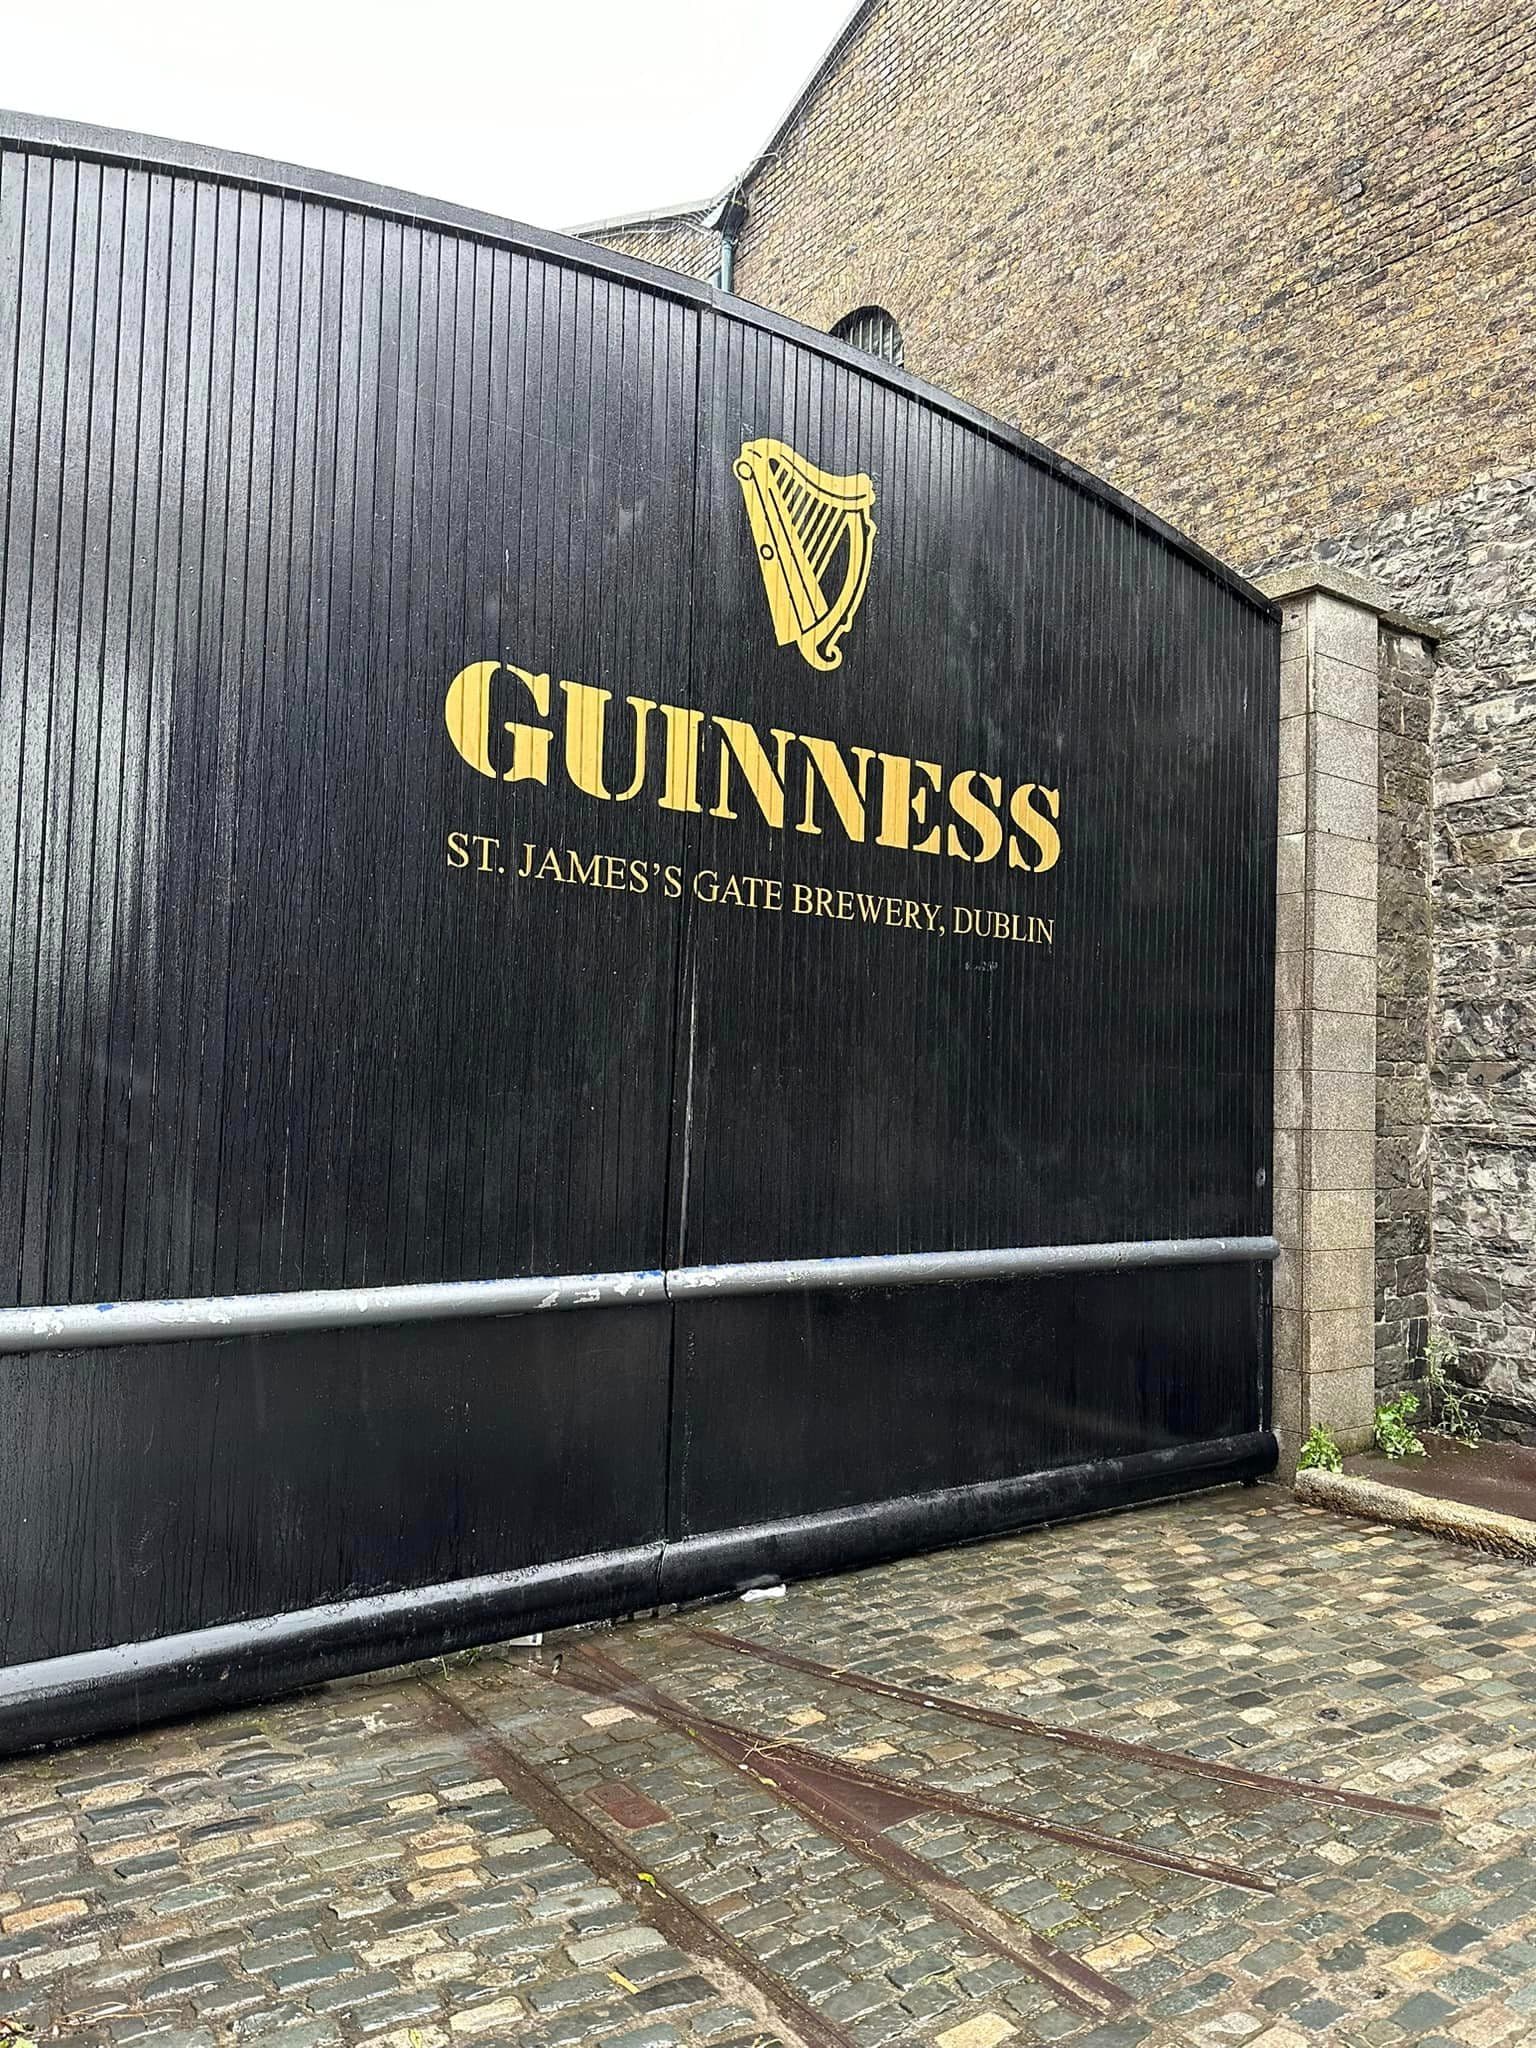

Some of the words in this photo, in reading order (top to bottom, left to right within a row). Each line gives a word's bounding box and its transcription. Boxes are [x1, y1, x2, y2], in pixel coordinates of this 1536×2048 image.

[444, 660, 1061, 873] GUINNESS
[446, 832, 505, 874] ST.
[693, 870, 782, 911] GATE
[792, 884, 946, 937] BREWERY,
[953, 906, 1055, 945] DUBLIN
